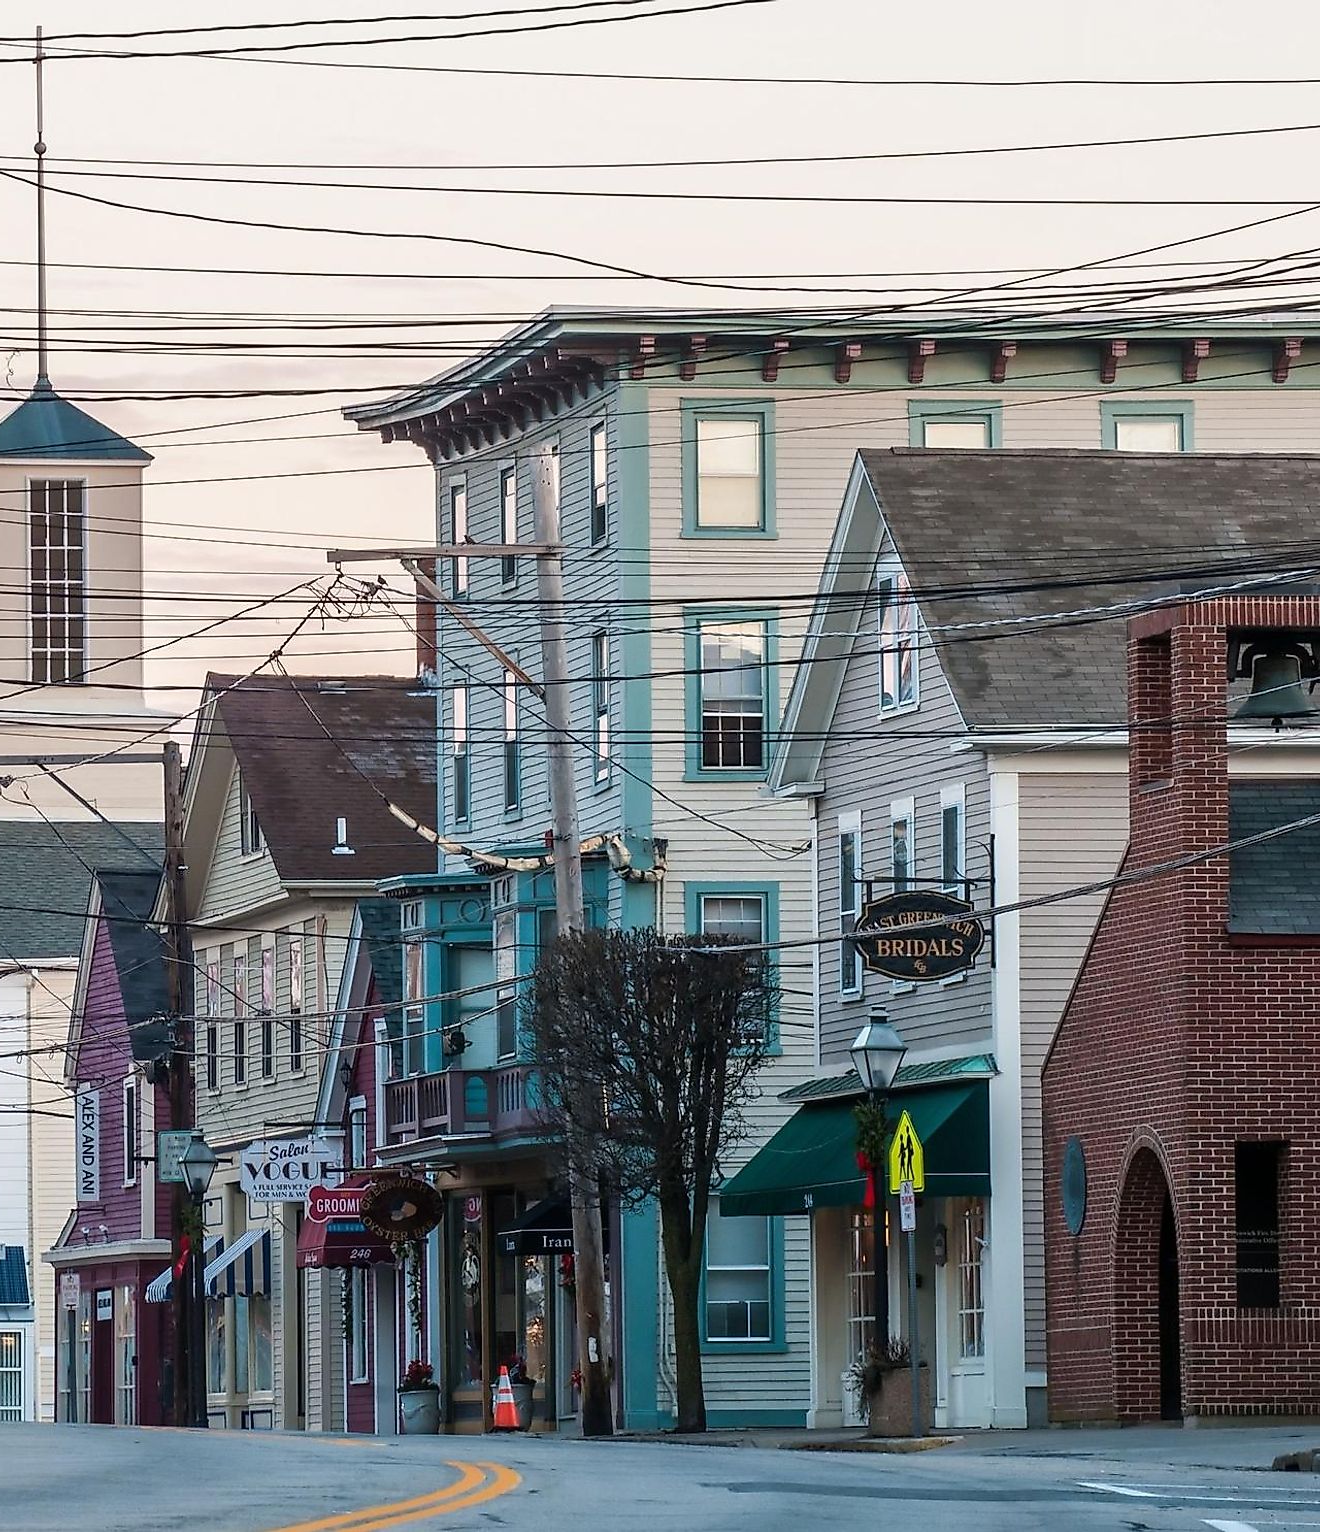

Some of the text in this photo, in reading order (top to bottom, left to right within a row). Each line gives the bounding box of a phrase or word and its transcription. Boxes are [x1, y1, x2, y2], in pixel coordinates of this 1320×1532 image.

[876, 938, 965, 957] BRIDALS
[81, 1096, 95, 1195] ALEX AND ANI
[269, 1142, 309, 1162] Salon
[243, 1161, 336, 1181] VOGUE
[316, 1198, 360, 1213] GROOMI
[363, 1216, 409, 1241] OYSTER
[542, 1235, 572, 1248] Iran
[350, 1248, 372, 1259] 246
